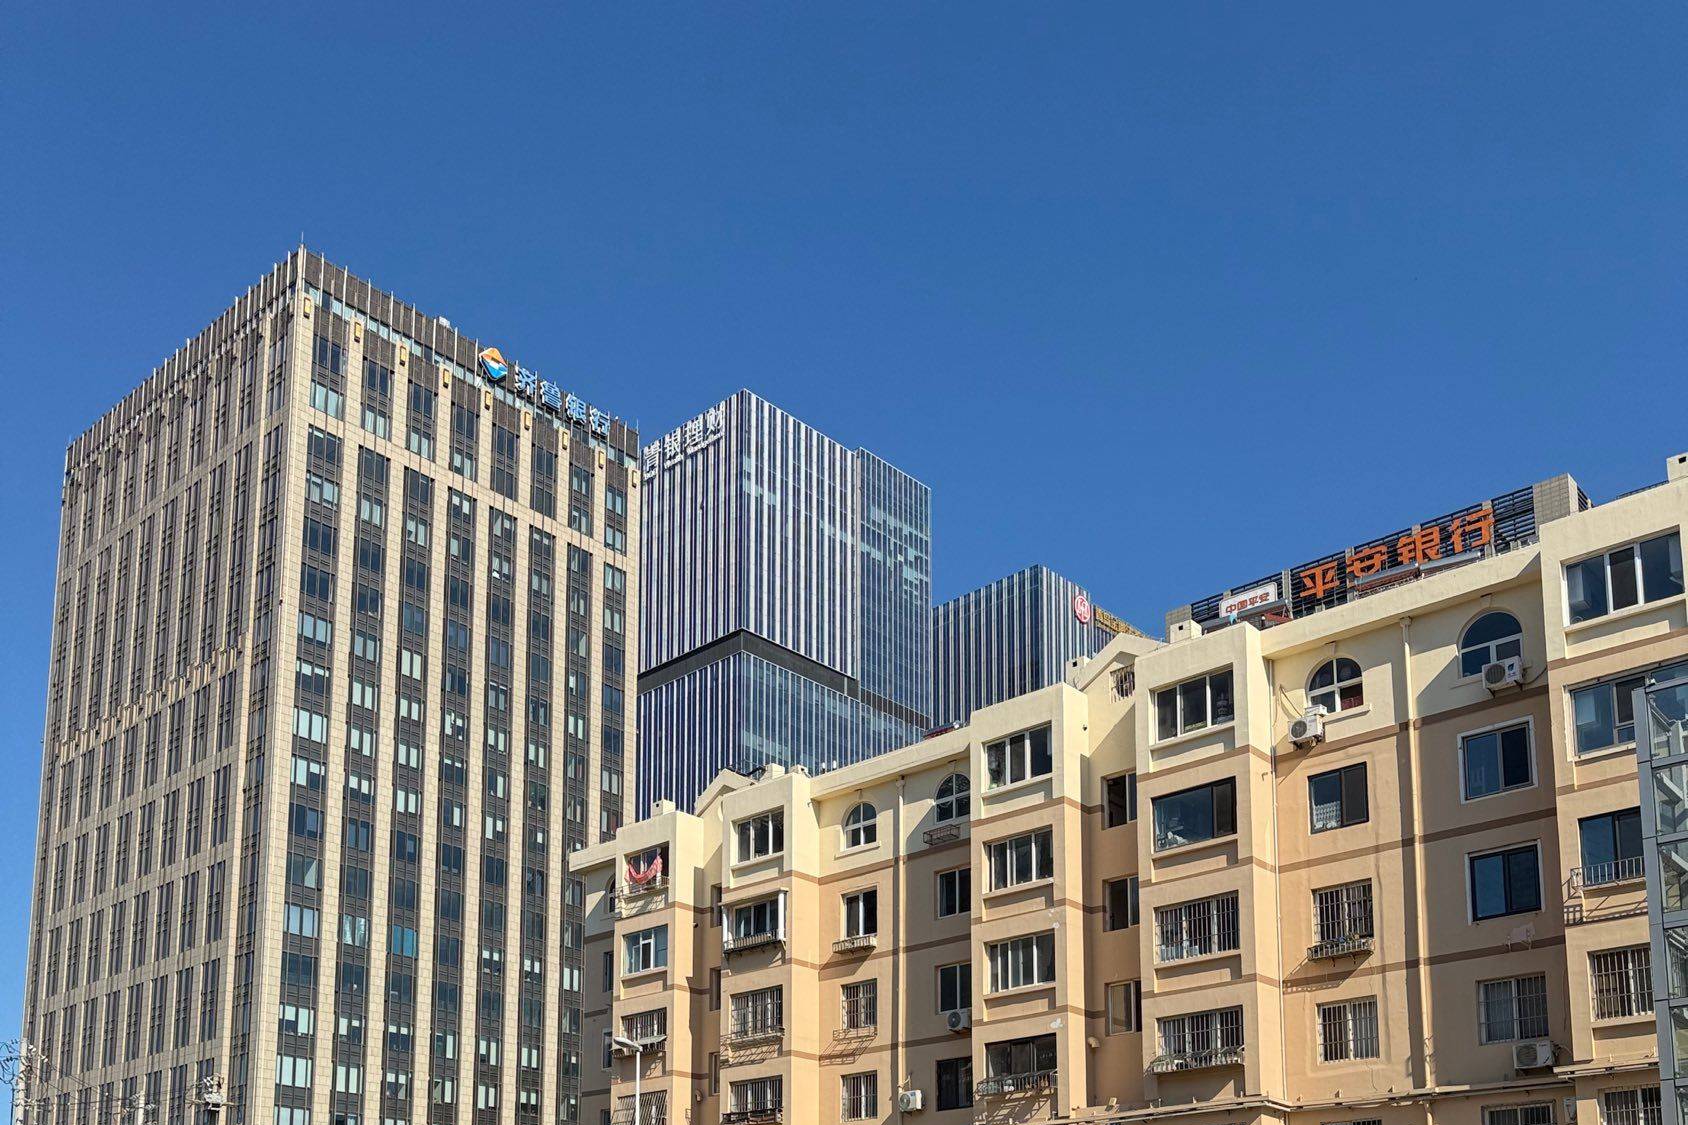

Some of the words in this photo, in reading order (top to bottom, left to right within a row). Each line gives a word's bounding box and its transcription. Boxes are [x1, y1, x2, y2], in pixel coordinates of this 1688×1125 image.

[515, 367, 610, 436] 齐鲁银行
[1299, 508, 1495, 598] 平安银行
[1226, 592, 1270, 613] 中国平安
